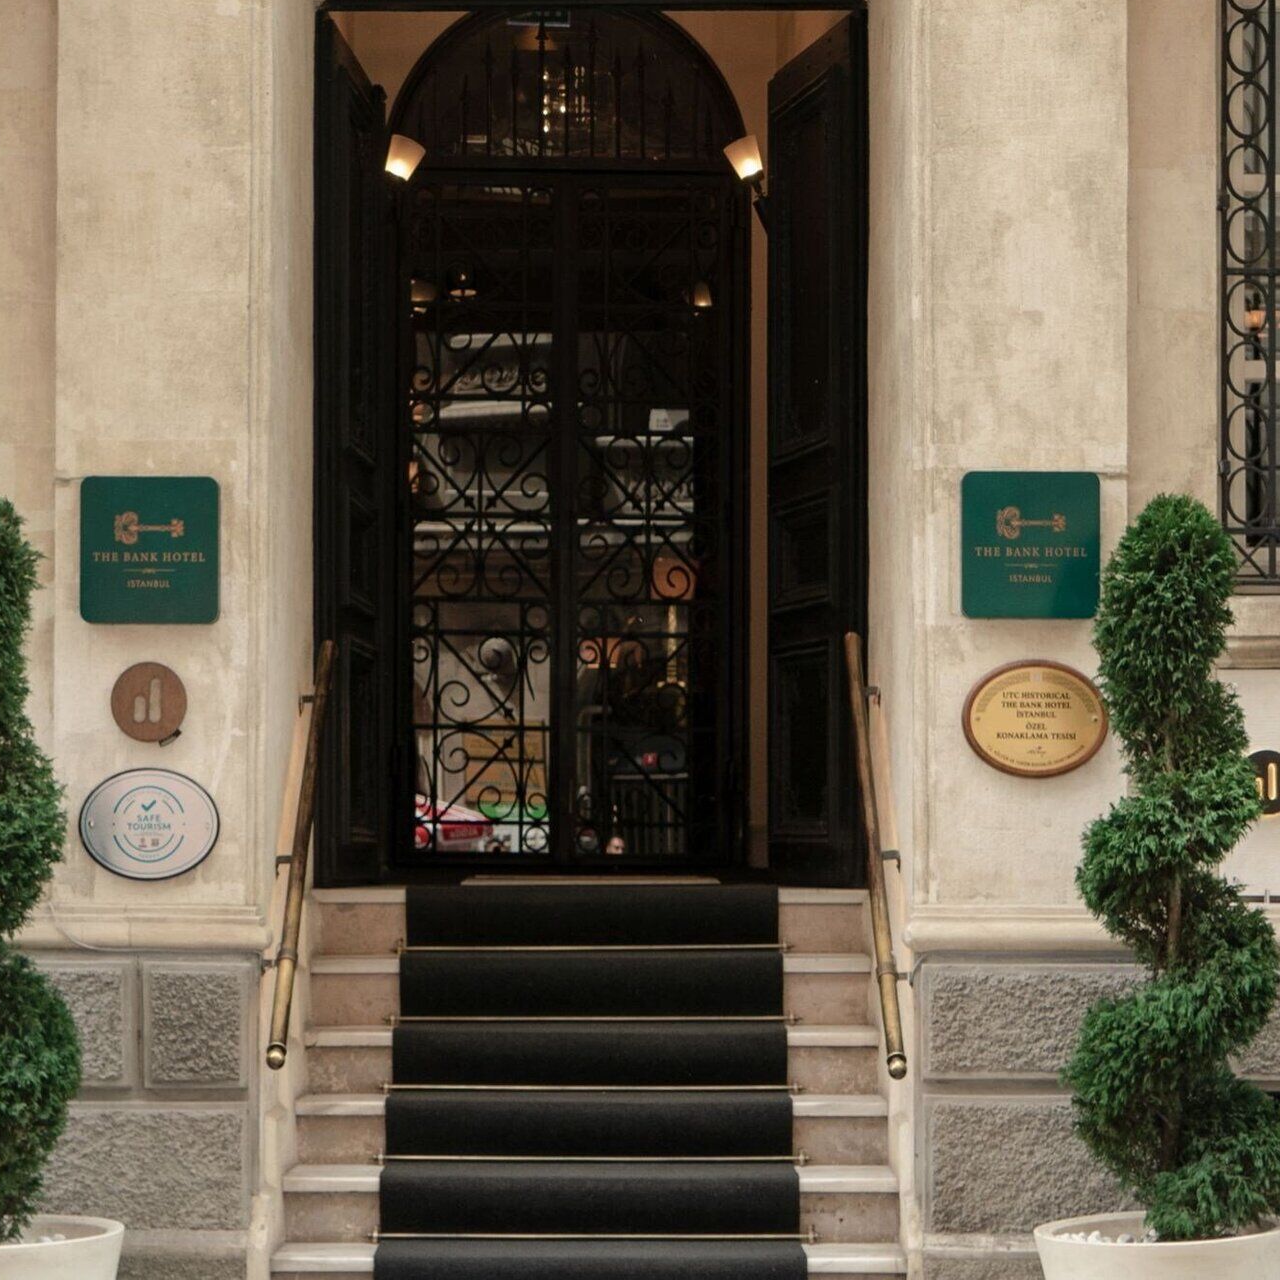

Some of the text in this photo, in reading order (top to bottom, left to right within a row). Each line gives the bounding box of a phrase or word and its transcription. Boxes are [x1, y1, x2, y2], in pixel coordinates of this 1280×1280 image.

[92, 551, 206, 562] THE BANK HOTEL
[974, 546, 1088, 558] THE BANK HOTEL
[1021, 691, 1071, 700] HISTORICAL
[1000, 700, 1072, 710] THE BANK HOTEL
[996, 731, 1049, 740] KONAKLAMA
[136, 814, 161, 822] SAFE
[126, 823, 172, 831] TOURISM
